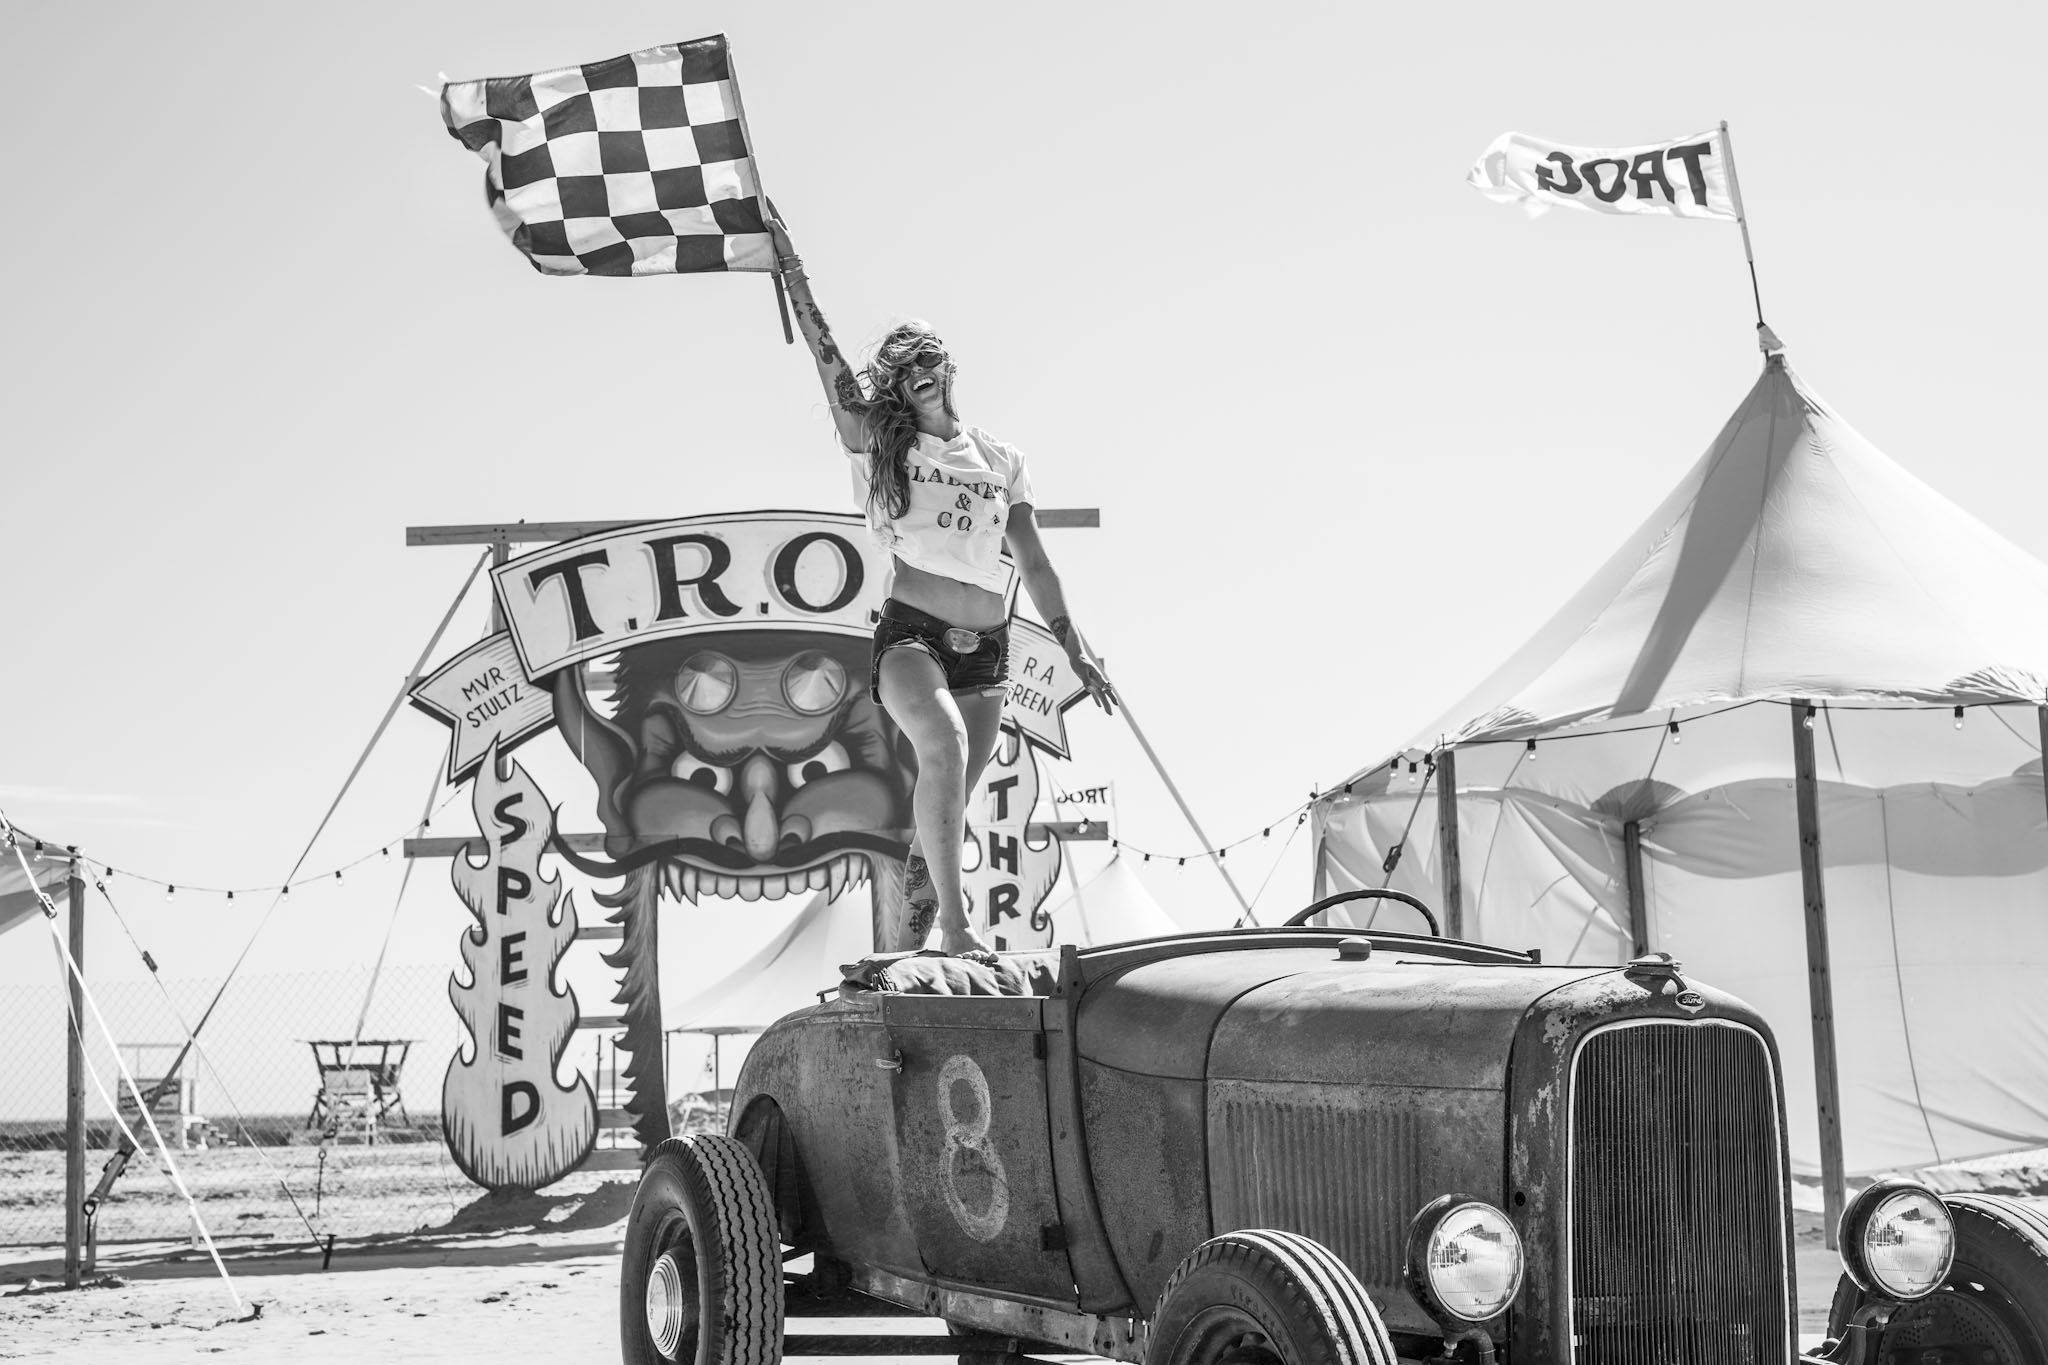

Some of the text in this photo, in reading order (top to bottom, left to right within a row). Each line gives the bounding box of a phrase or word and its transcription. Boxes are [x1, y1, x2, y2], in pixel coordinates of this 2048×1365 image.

[955, 493, 972, 512] &
[526, 531, 890, 644] T.R.O.
[1008, 683, 1054, 716] REEN
[494, 792, 540, 1138] SPEED
[1682, 994, 1703, 1004] Ford
[937, 1054, 1009, 1243] 8
